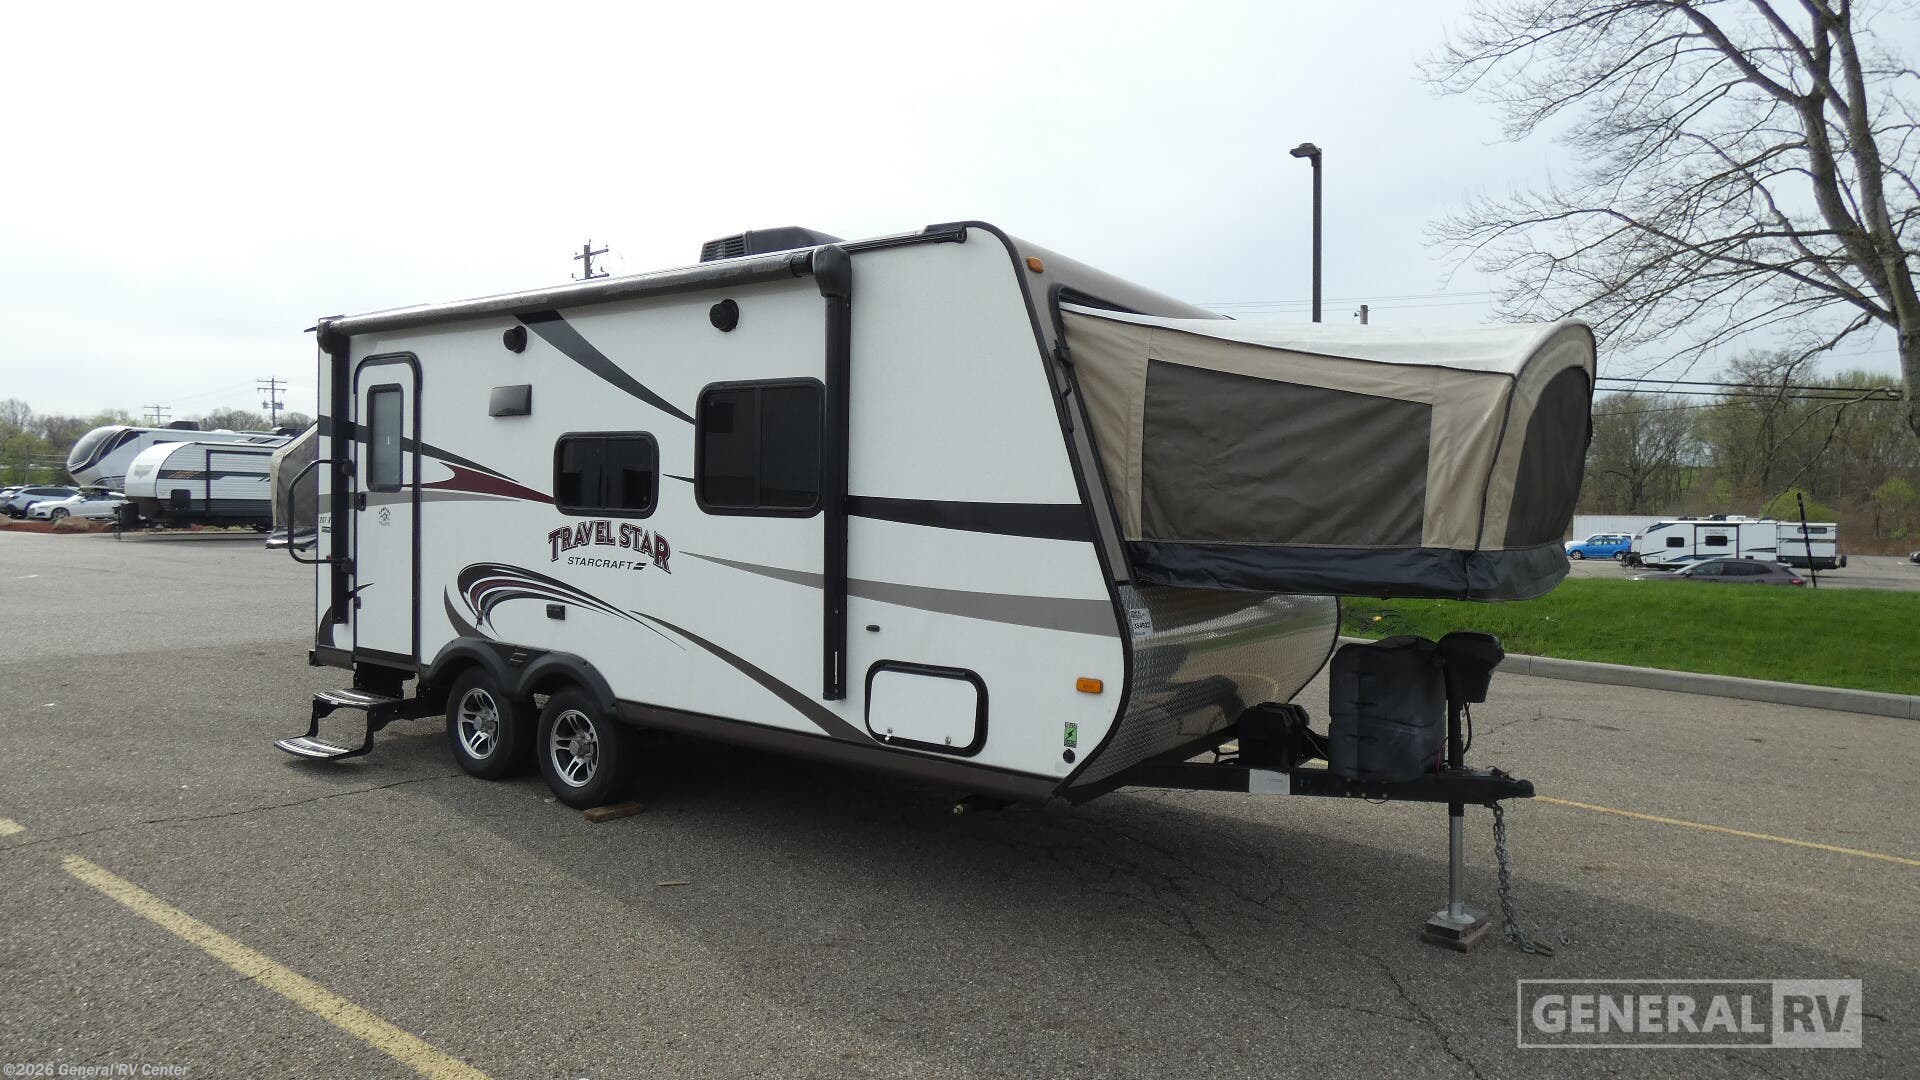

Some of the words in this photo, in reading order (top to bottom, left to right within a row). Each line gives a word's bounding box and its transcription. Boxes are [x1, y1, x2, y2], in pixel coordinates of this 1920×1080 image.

[548, 520, 616, 563] TRAVEL
[618, 522, 672, 575] STAR
[567, 556, 634, 571] STARCRAFT
